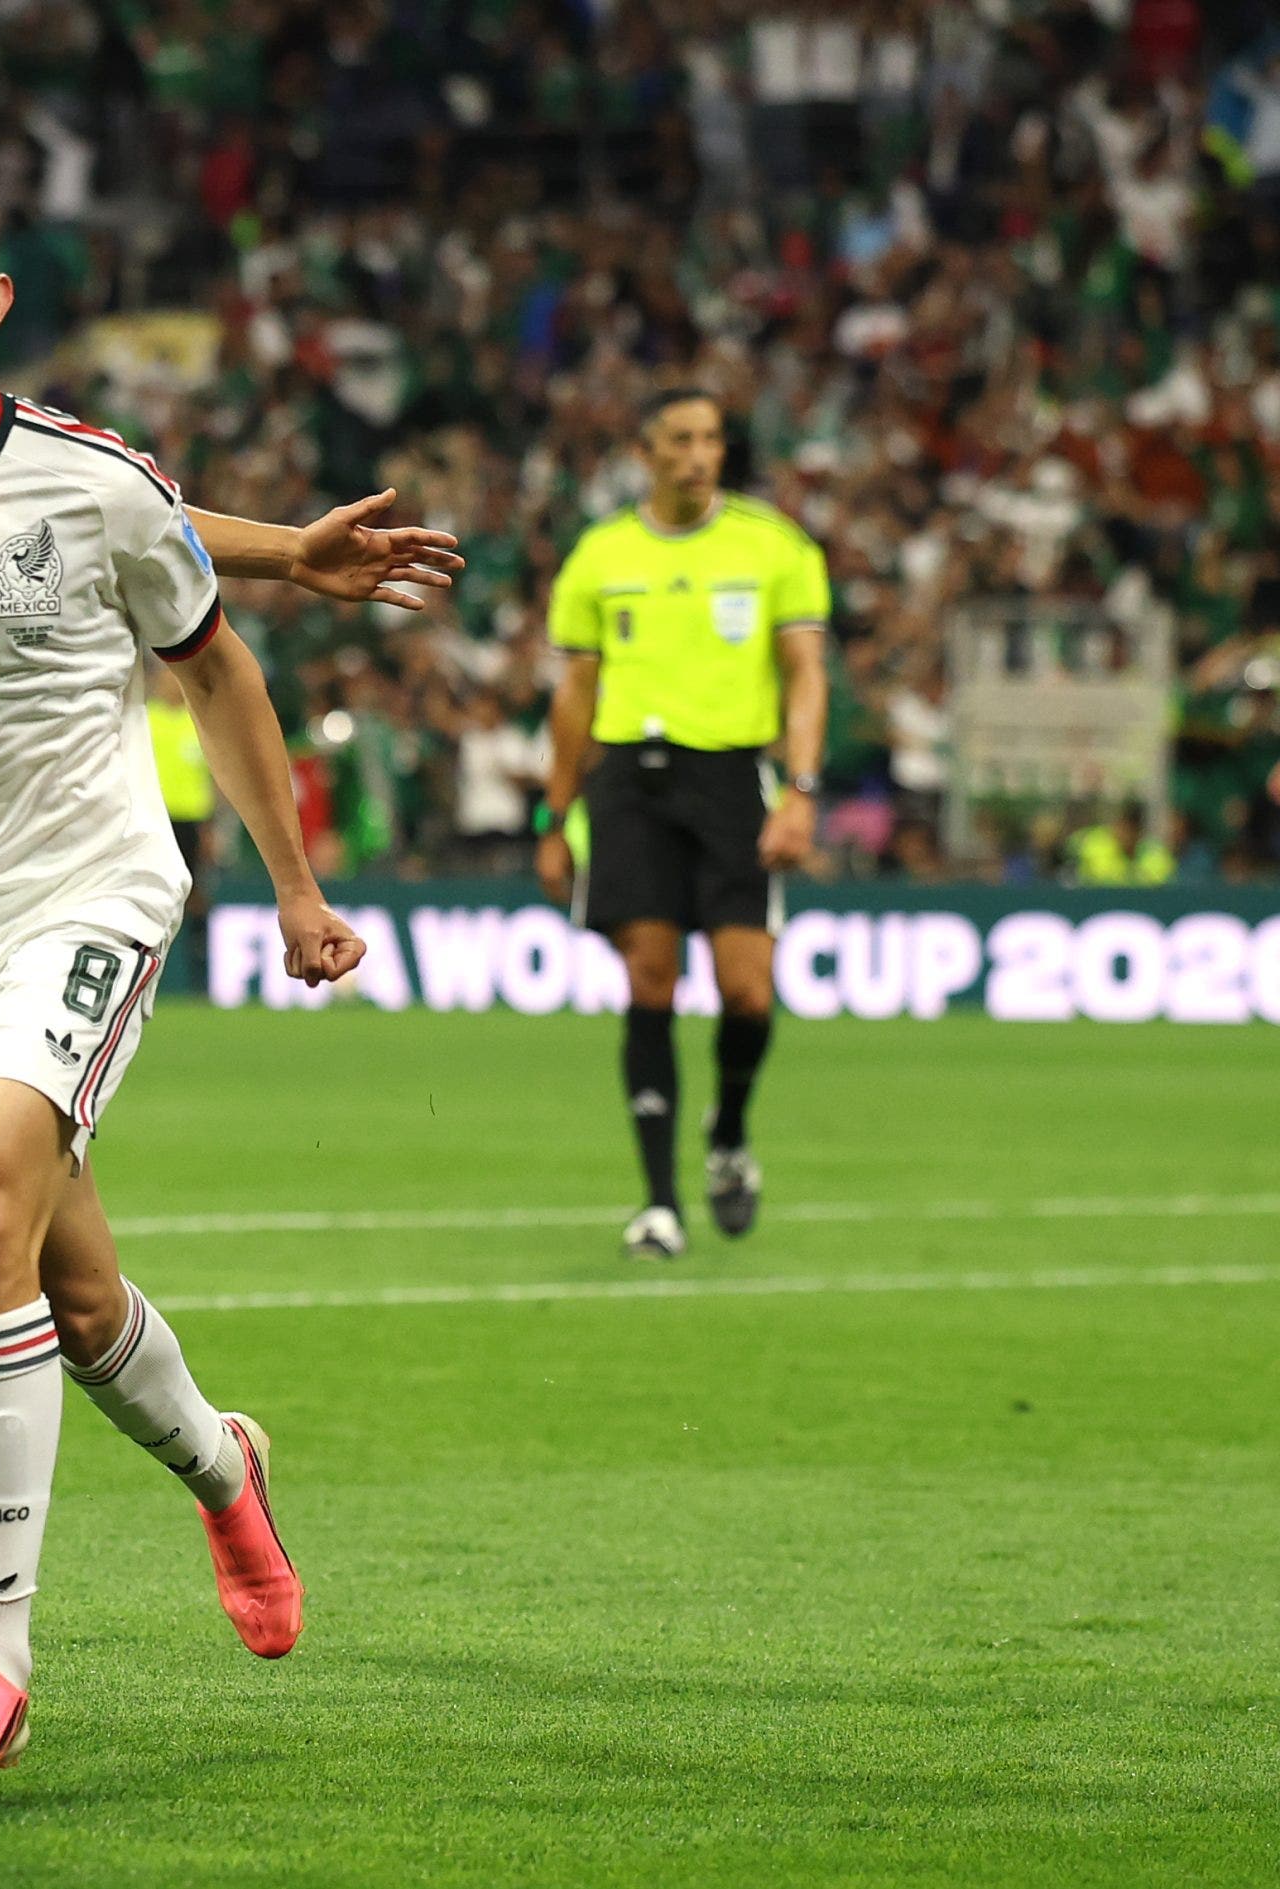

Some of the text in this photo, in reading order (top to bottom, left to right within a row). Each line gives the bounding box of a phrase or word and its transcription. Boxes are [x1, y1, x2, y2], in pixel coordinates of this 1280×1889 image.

[62, 944, 122, 1026] 8
[208, 904, 411, 1011] FIA
[409, 905, 721, 1015] WOR
[774, 910, 982, 1020] CUP
